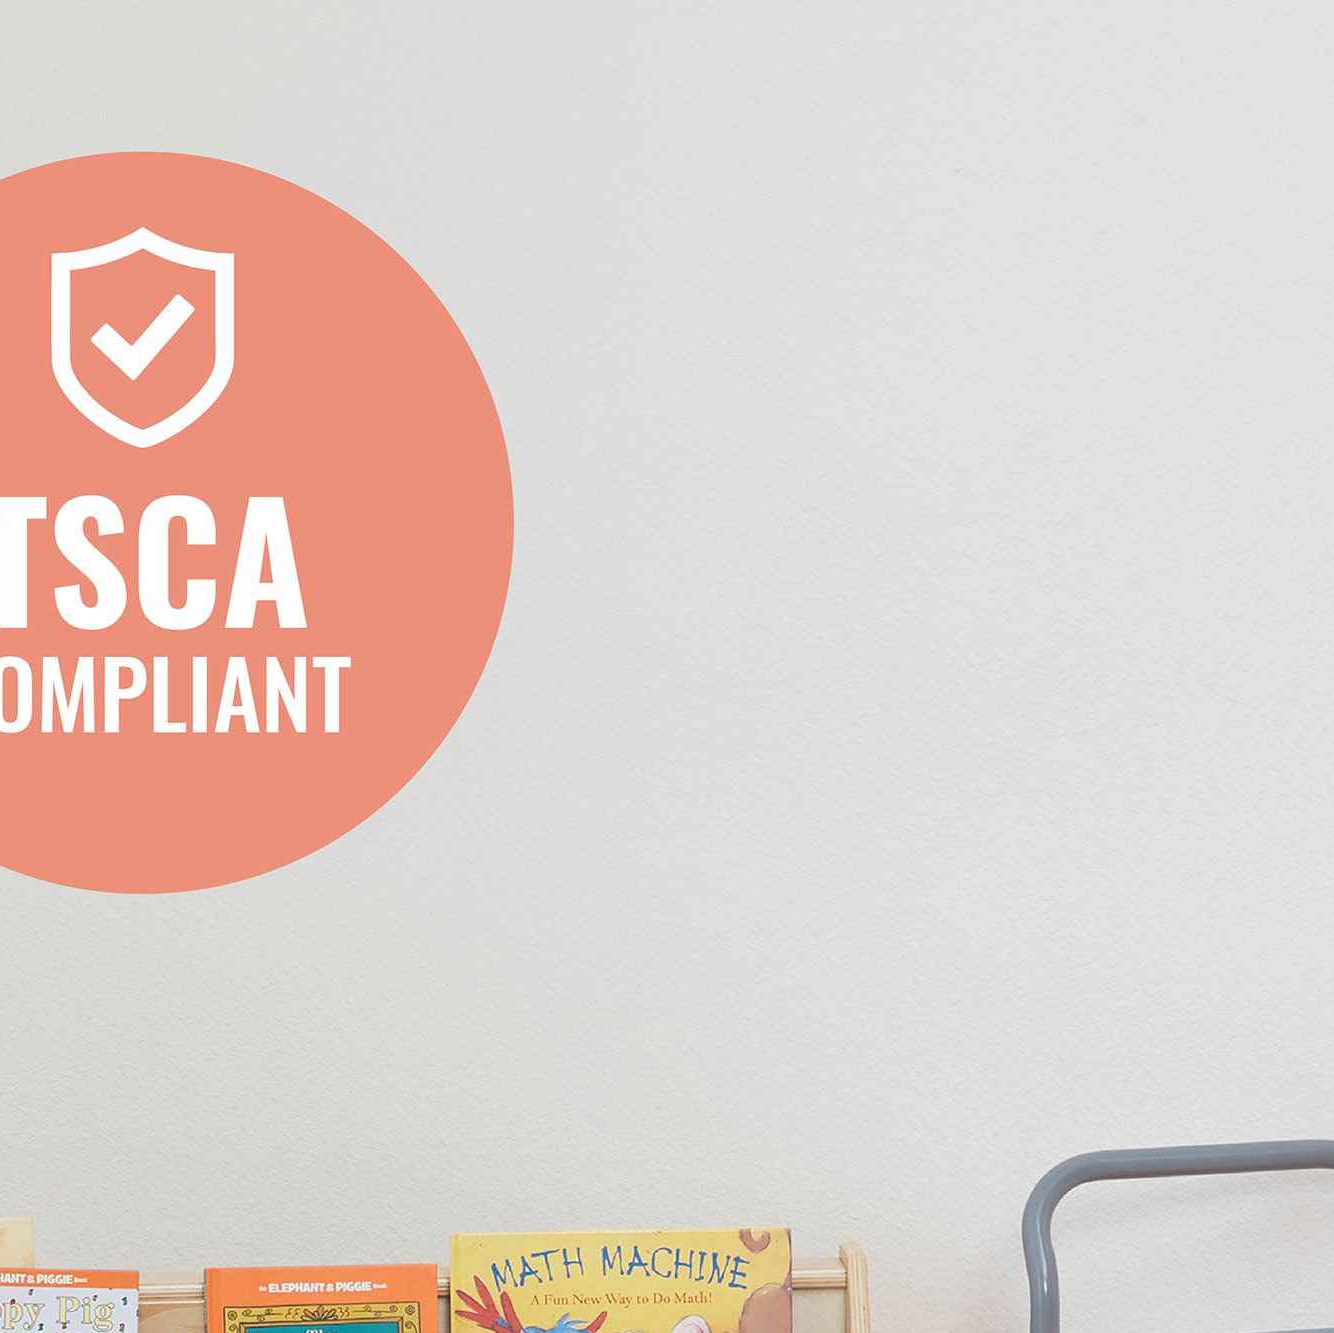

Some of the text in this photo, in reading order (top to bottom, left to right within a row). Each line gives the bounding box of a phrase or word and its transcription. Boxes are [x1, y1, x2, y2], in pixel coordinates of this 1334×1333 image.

[491, 1245, 750, 1293] MATH MACHINE
[27, 1275, 35, 1283] &
[36, 1274, 73, 1284] PIGGIE
[268, 1283, 325, 1293] ELEPHANT
[326, 1284, 334, 1292] &
[336, 1282, 372, 1292] PIGGIE
[531, 1291, 713, 1308] A Fun New Way to Do Math!
[56, 1296, 115, 1332] Pig
